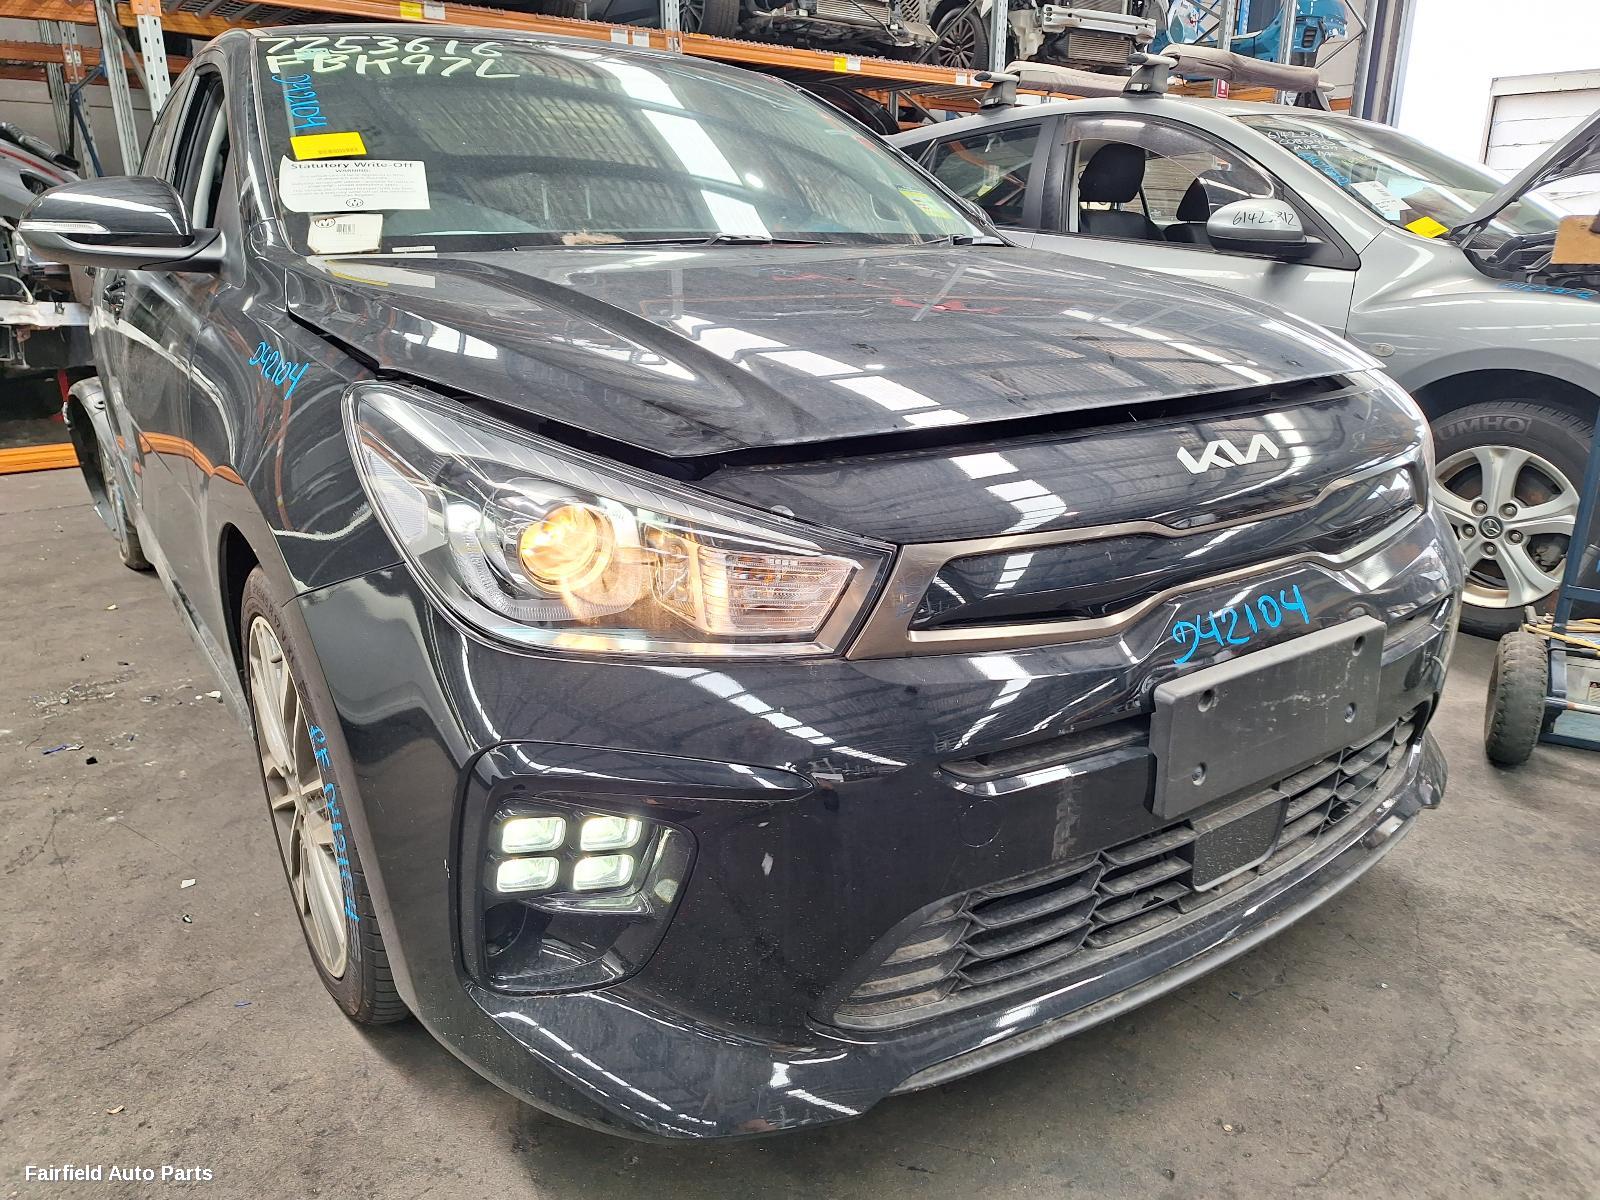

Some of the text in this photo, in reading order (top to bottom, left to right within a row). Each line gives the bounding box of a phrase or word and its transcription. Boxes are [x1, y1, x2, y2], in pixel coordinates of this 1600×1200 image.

[265, 54, 521, 78] FBK97L
[1439, 416, 1526, 439] UMHO
[1176, 433, 1280, 474] KIA
